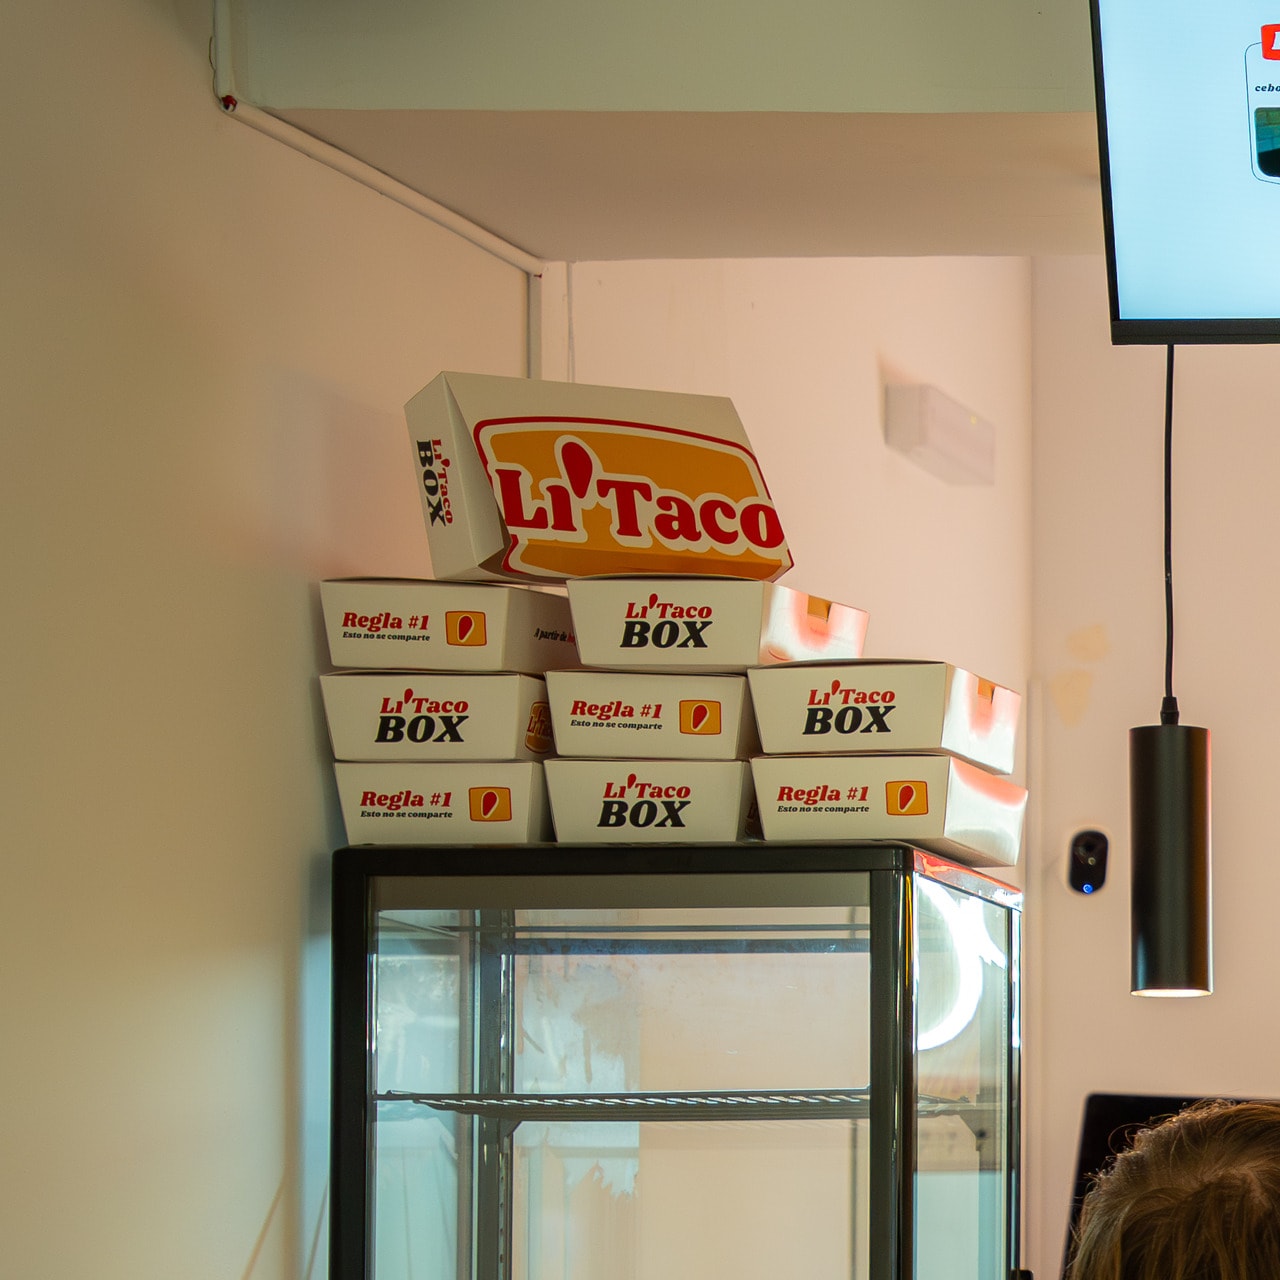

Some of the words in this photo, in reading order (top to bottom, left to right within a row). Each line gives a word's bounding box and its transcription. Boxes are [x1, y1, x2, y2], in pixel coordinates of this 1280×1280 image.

[417, 440, 446, 527] BOX
[494, 441, 785, 548] Li'Taco
[341, 612, 403, 632] Regla
[408, 615, 429, 631] #1
[342, 631, 362, 641] Esto
[363, 633, 375, 641] no
[376, 633, 386, 641] se
[387, 633, 430, 642] comparte
[619, 620, 713, 648] BOX
[570, 700, 635, 720] Regla
[640, 703, 662, 719] #1
[802, 705, 896, 735] BOX
[374, 715, 469, 743] BOX
[570, 719, 591, 728] Esto
[592, 721, 604, 729] no
[605, 721, 616, 729] se
[617, 721, 663, 730] comparte
[360, 790, 424, 811] Regla
[430, 792, 452, 807] #1
[777, 784, 841, 805] Regla
[847, 786, 869, 801] #1
[360, 810, 381, 818] Esto
[395, 811, 405, 819] se
[407, 811, 453, 820] comparte
[597, 800, 691, 827] BOX
[777, 805, 798, 813] Esto
[824, 805, 869, 815] comparte
